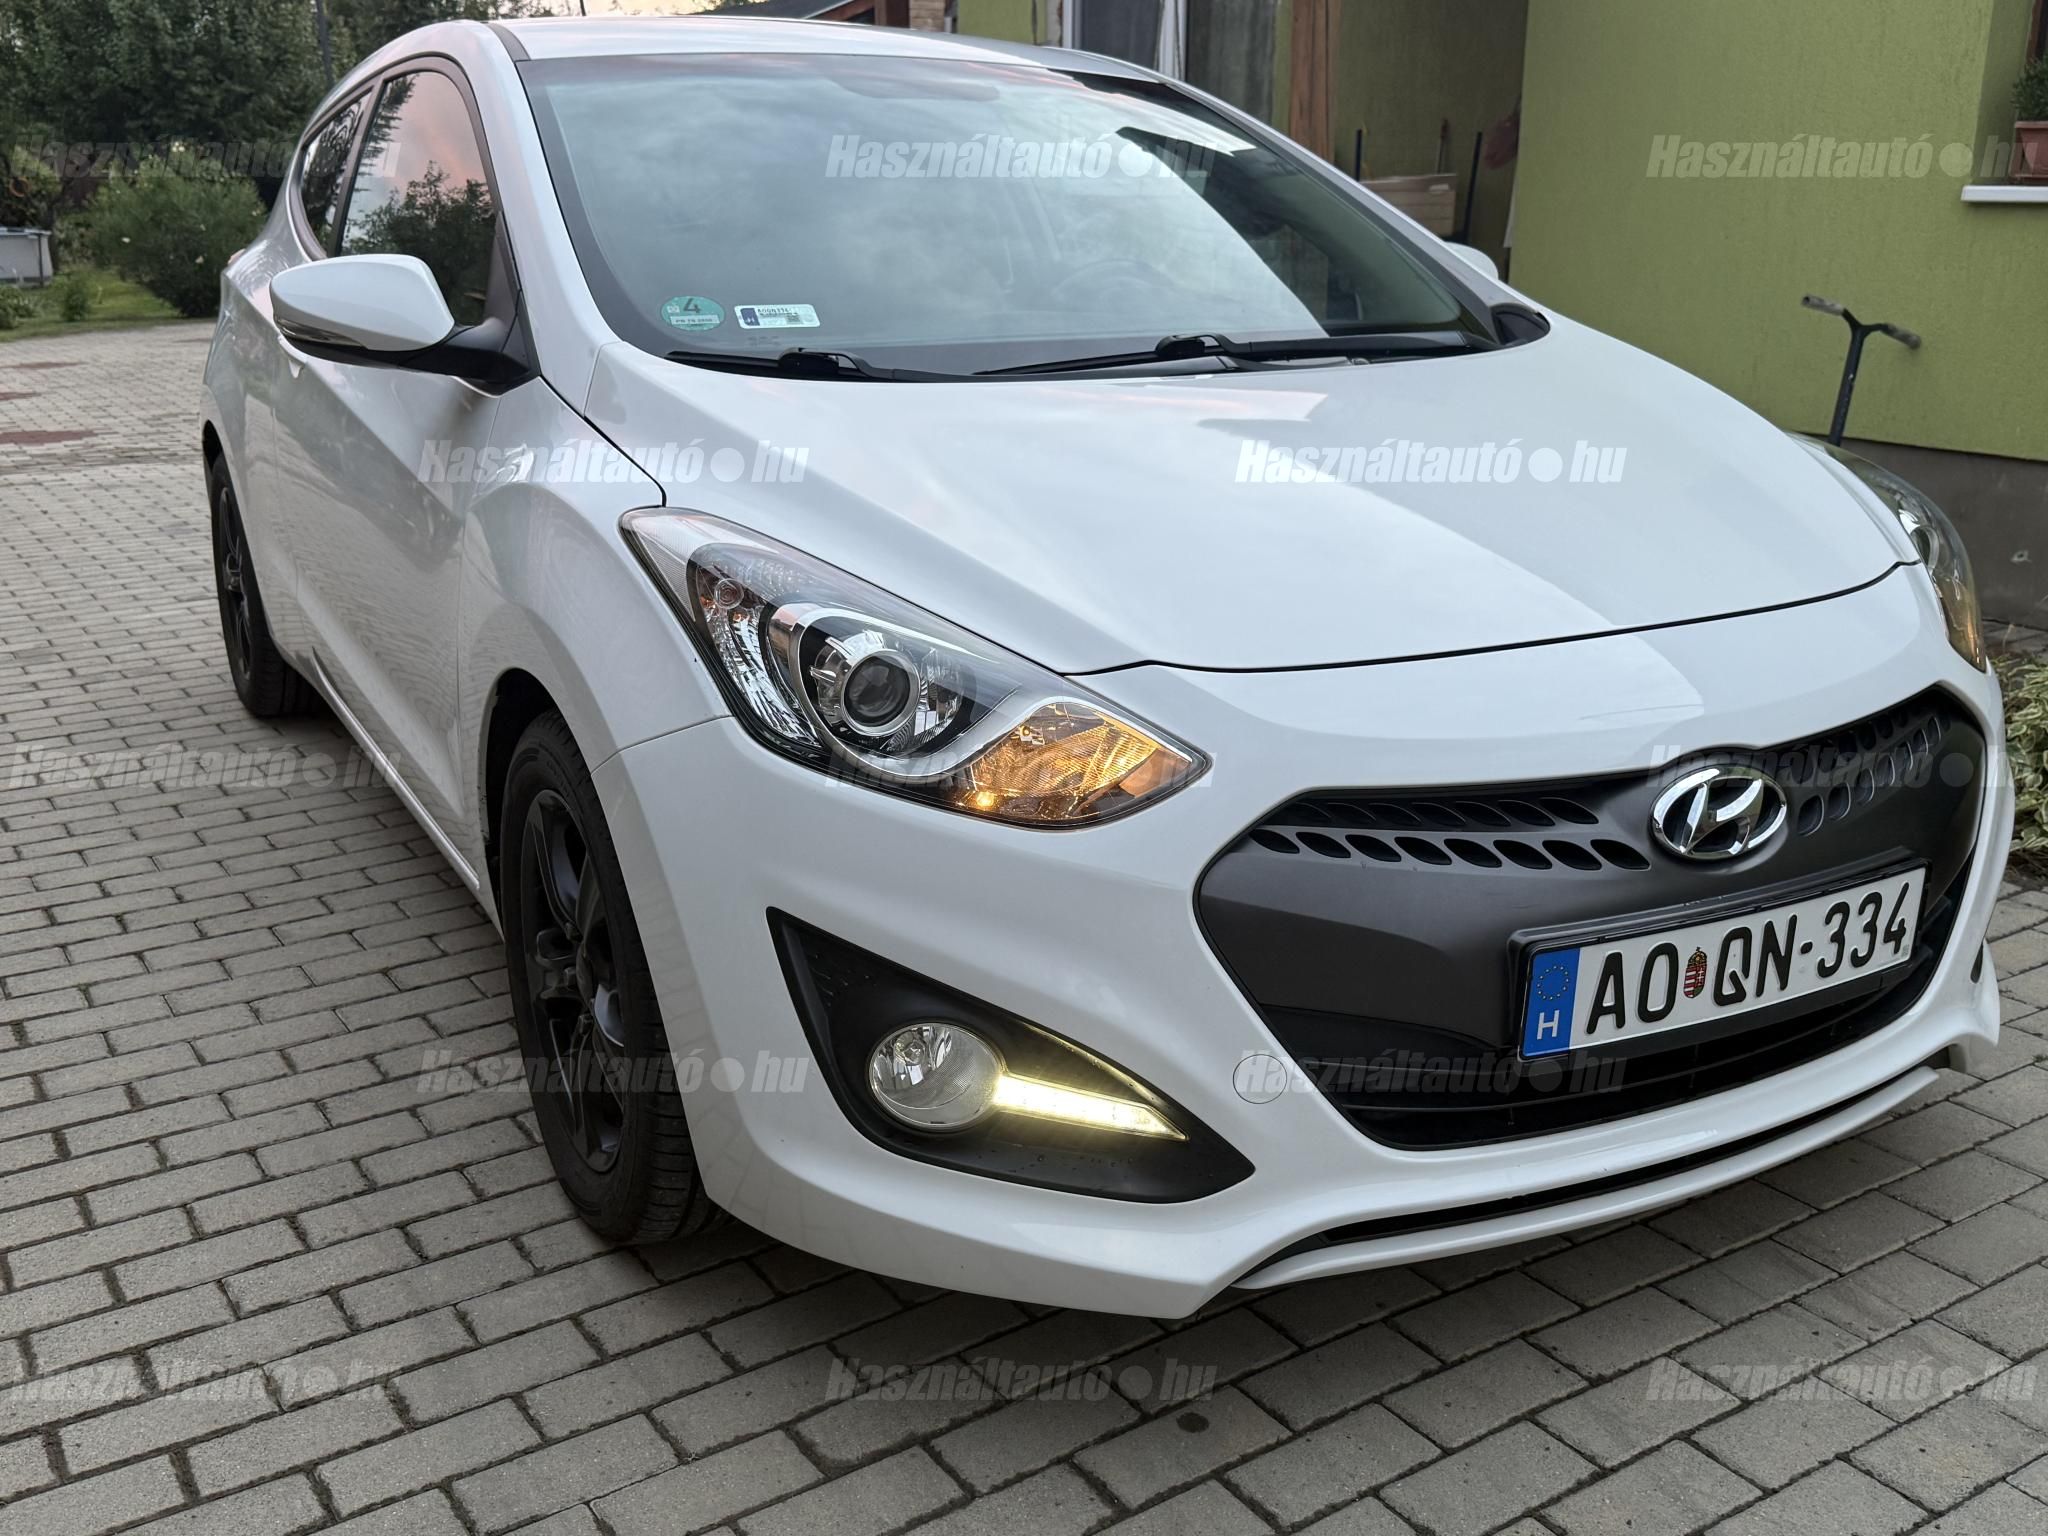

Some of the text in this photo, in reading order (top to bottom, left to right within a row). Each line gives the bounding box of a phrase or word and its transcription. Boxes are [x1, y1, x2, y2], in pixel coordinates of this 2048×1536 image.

[683, 297, 702, 314] 4
[1586, 882, 1910, 1035] AO QN-334
[1536, 1009, 1560, 1041] H
